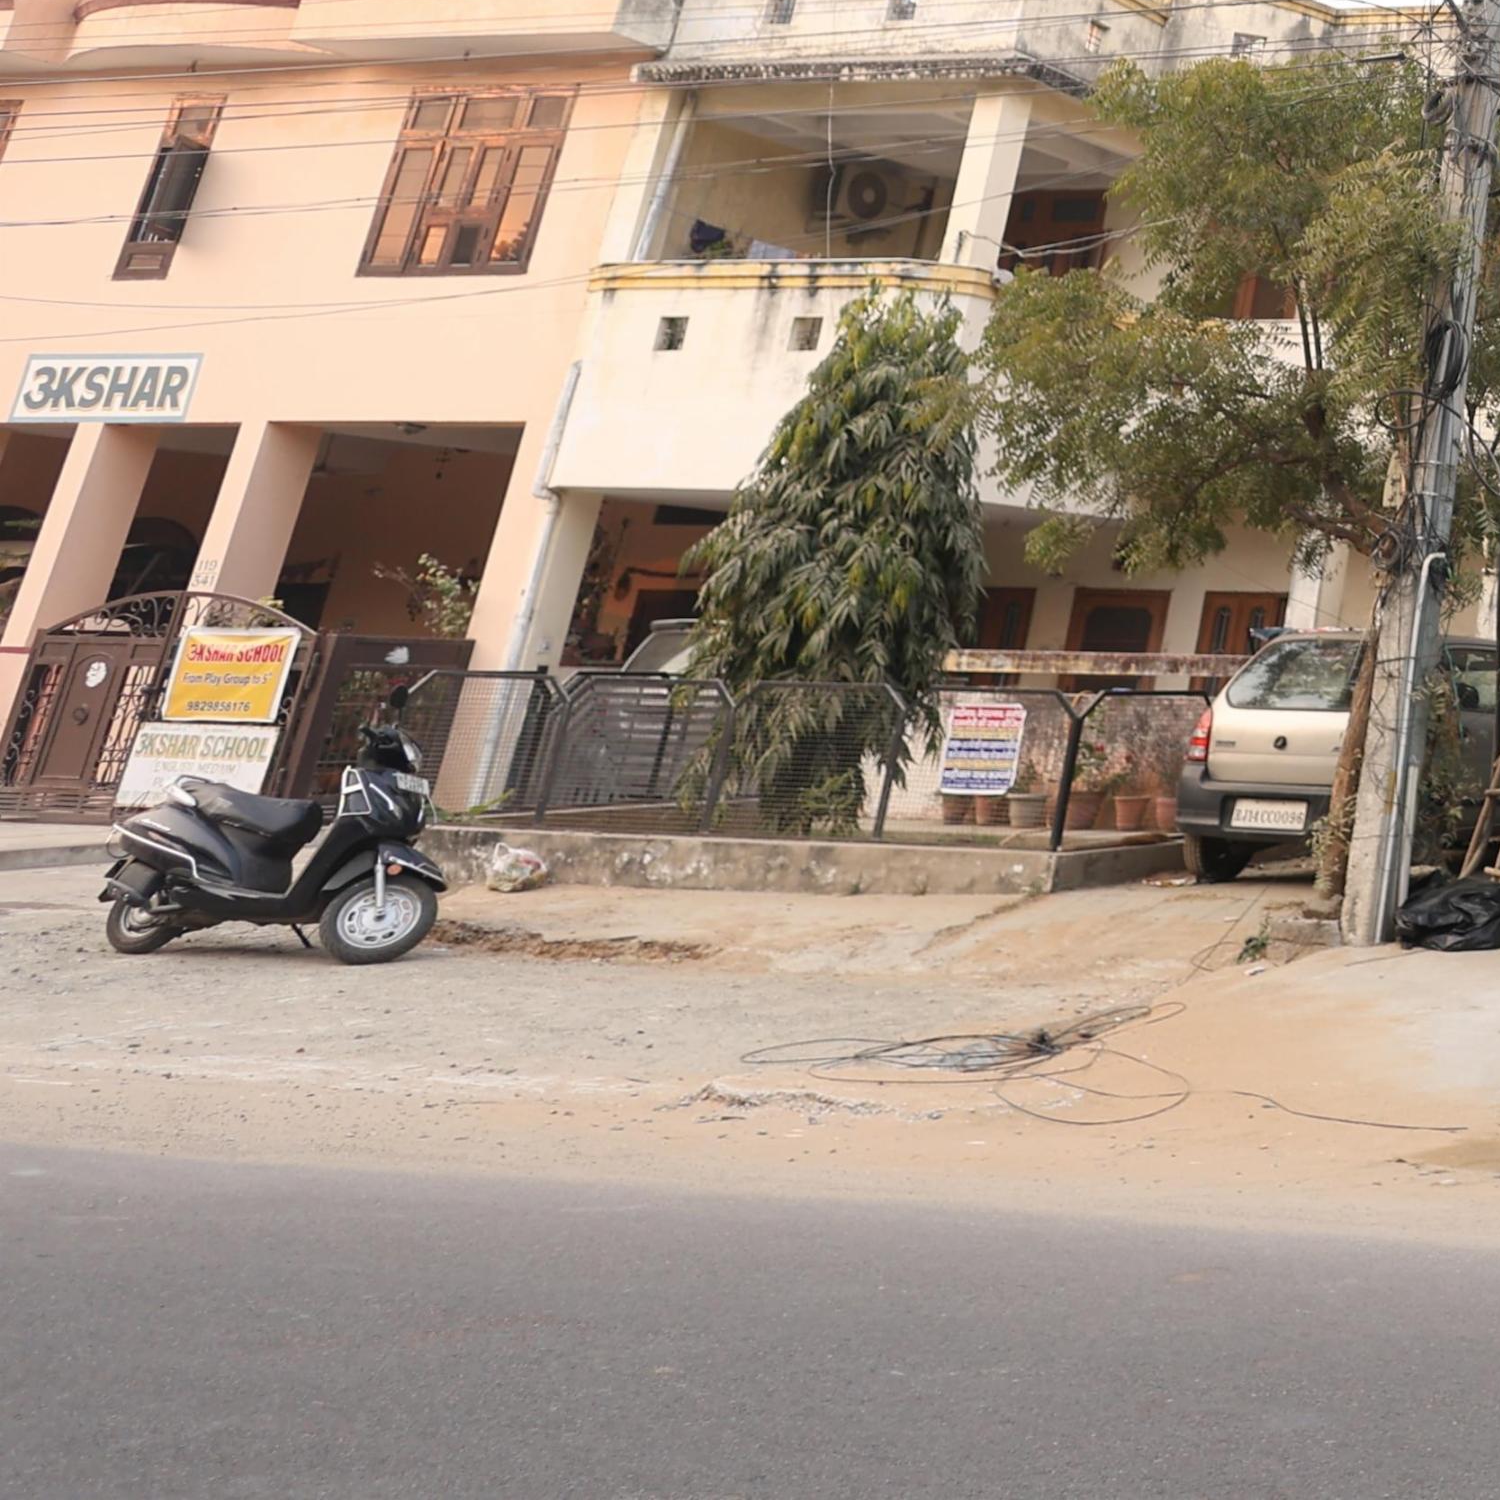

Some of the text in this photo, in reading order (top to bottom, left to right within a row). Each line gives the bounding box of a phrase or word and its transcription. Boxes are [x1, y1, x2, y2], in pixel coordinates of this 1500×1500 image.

[235, 644, 285, 663] SCHOOL
[183, 672, 203, 681] From
[204, 672, 221, 685] Play
[223, 673, 250, 685] Group
[200, 735, 270, 760] SCHOOL
